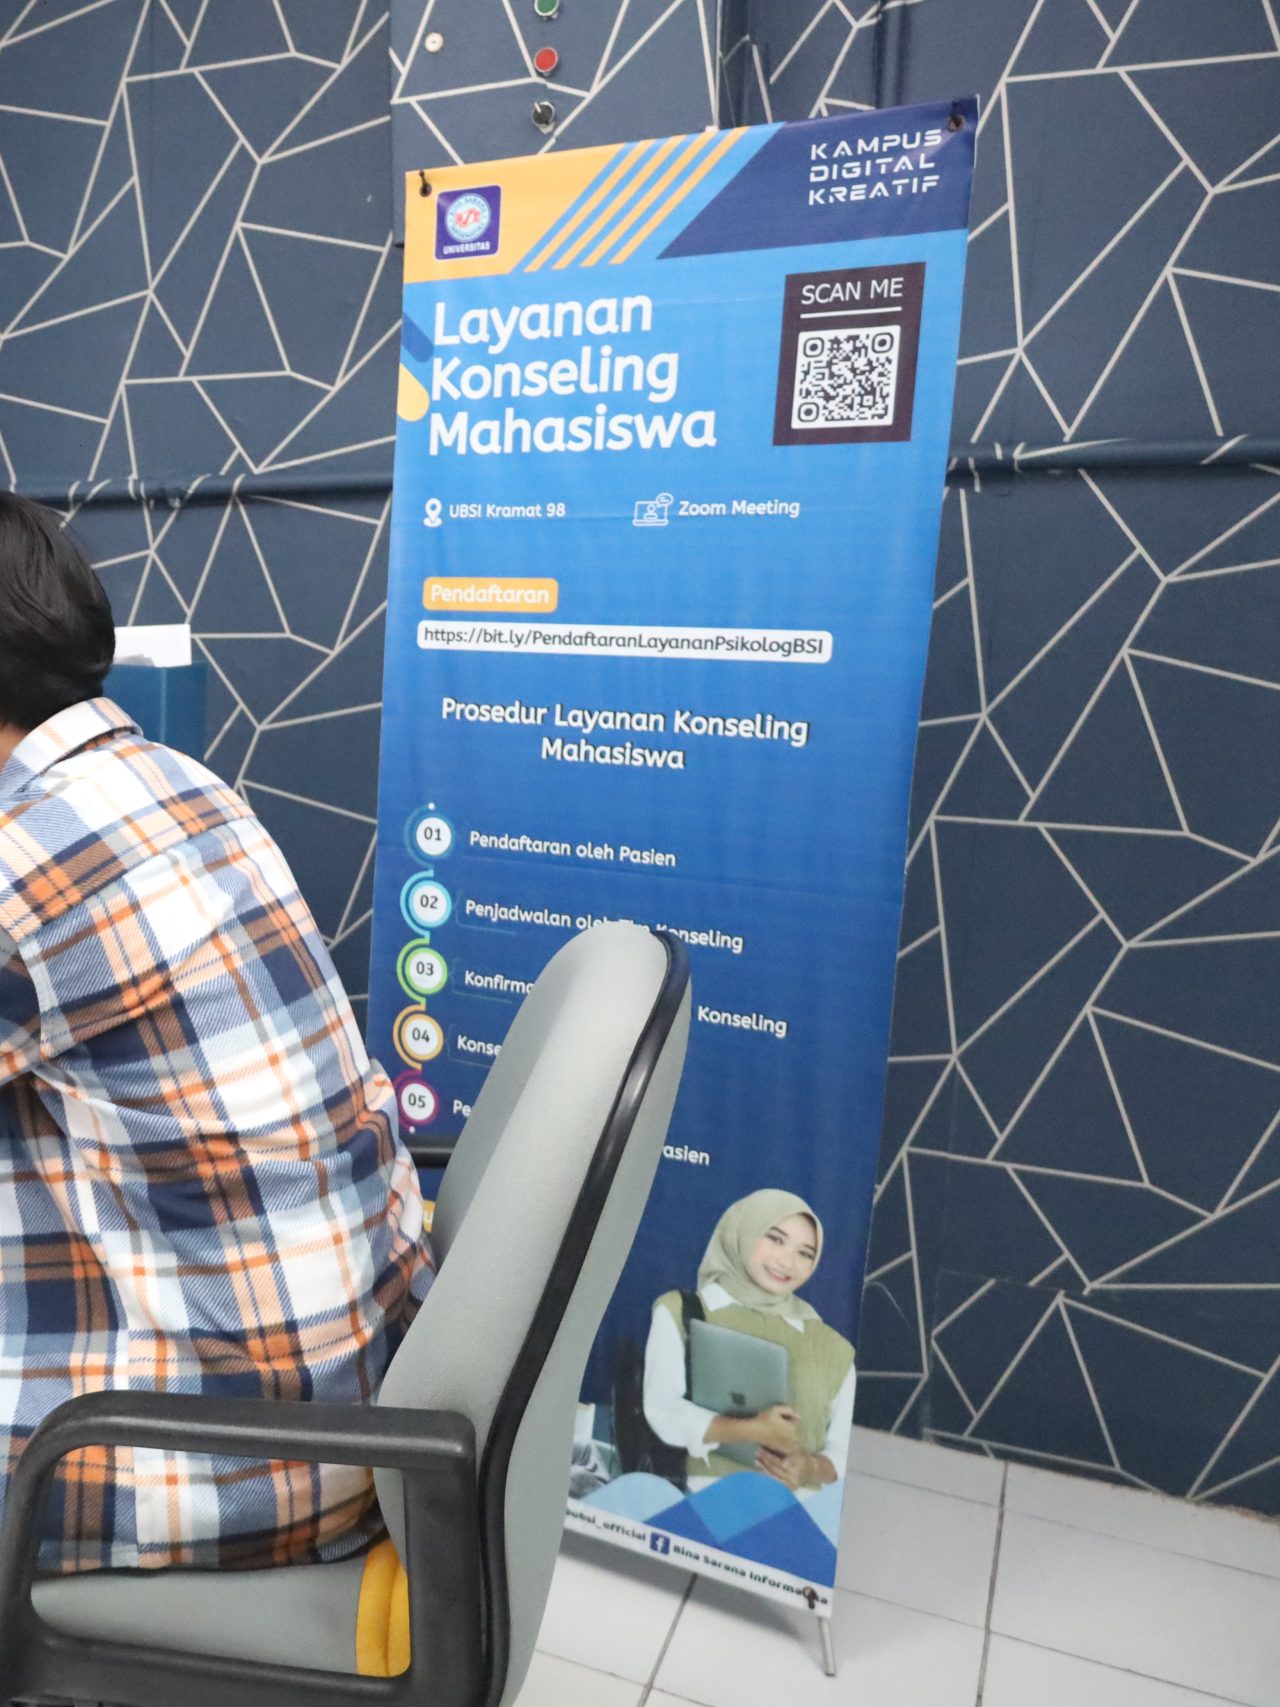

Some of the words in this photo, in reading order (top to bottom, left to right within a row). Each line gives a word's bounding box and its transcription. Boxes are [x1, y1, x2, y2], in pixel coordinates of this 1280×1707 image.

[810, 129, 942, 161] KAMPUS
[809, 153, 935, 182] DIGITAL
[808, 174, 940, 206] KREATIF
[443, 241, 490, 254] UNIVERSITAS
[800, 281, 861, 305] SCAN
[870, 277, 904, 299] ME
[434, 294, 653, 355] Layanan
[431, 344, 679, 403] Konseling
[429, 403, 717, 456] Mahasiswa
[449, 503, 482, 518] UBSI
[486, 503, 543, 518] Kramat
[546, 502, 566, 517] 98
[678, 501, 726, 516] Zoom
[731, 499, 801, 519] Meeting
[430, 584, 549, 604] Pendaftaran
[423, 626, 824, 657] https://bit.ly/PendaftaranLayananPsikologBSI
[441, 697, 548, 725] Prosedur
[554, 703, 665, 733] Layanan
[673, 709, 810, 747] Konseling
[540, 736, 685, 770] Mahasiswa
[423, 826, 443, 842] 01
[469, 830, 572, 857] Pendaftaran
[575, 841, 615, 861] oleh
[619, 845, 677, 867] Pasien
[419, 893, 439, 910] 02
[465, 899, 572, 928] Penjadwalan
[415, 961, 435, 977] 03
[411, 1027, 431, 1043] 04
[697, 1005, 788, 1039] Konseling
[408, 1092, 427, 1109] 05
[662, 1144, 711, 1167] asien
[703, 1554, 746, 1577] Sarana
